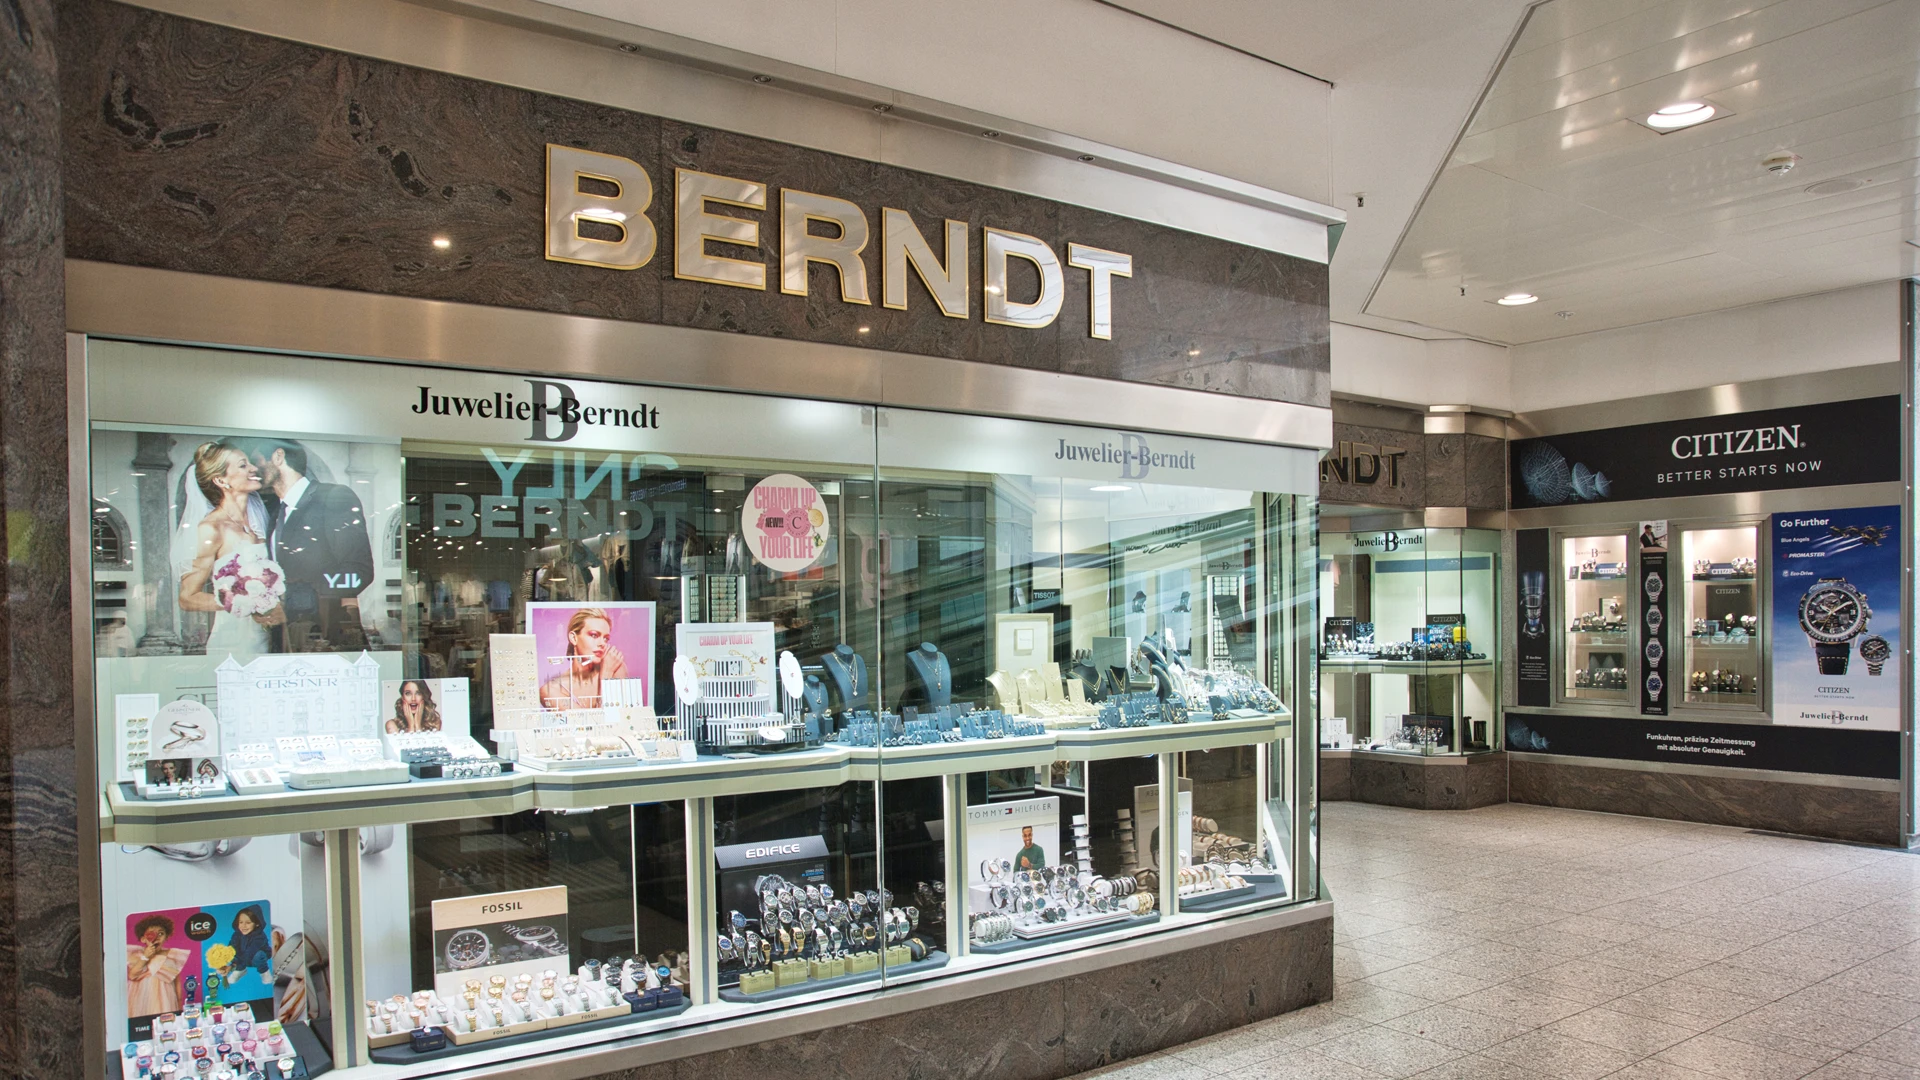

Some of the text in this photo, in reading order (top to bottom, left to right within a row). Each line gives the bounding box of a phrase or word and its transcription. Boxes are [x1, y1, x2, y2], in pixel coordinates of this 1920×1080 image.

[544, 143, 1132, 340] BERNDT
[411, 385, 660, 429] Juwelier-Berndt
[1670, 425, 1801, 460] CITIZEN
[1055, 438, 1196, 470] Juwelier-Berndt
[1319, 440, 1406, 489] NDT
[1657, 460, 1823, 484] BETTER STARTS NOW
[753, 486, 817, 509] CHARM UP
[433, 493, 687, 541] BERNDT
[1780, 518, 1830, 528] Go Further
[759, 536, 814, 559] YOUR LIFE
[699, 635, 720, 646] CHARM
[729, 634, 743, 645] YOUR
[743, 634, 753, 645] LIFE
[255, 678, 338, 689] GERSTNER
[1818, 686, 1850, 694] CITIZEN
[1800, 712, 1869, 721] Juwelier-Berndt
[1646, 733, 1756, 747] Funkuhren, präzise Zeitmessung
[1669, 744, 1701, 753] absoluter
[1702, 746, 1746, 757] Genauigkeit.
[968, 807, 1003, 820] TOMMY
[745, 843, 801, 859] EDIFICE
[482, 901, 523, 915] FOSSIL
[190, 920, 211, 931] ice
[581, 1012, 599, 1020] FOSSIL
[135, 1025, 150, 1033] TIME
[492, 1028, 511, 1036] FOSSIL
